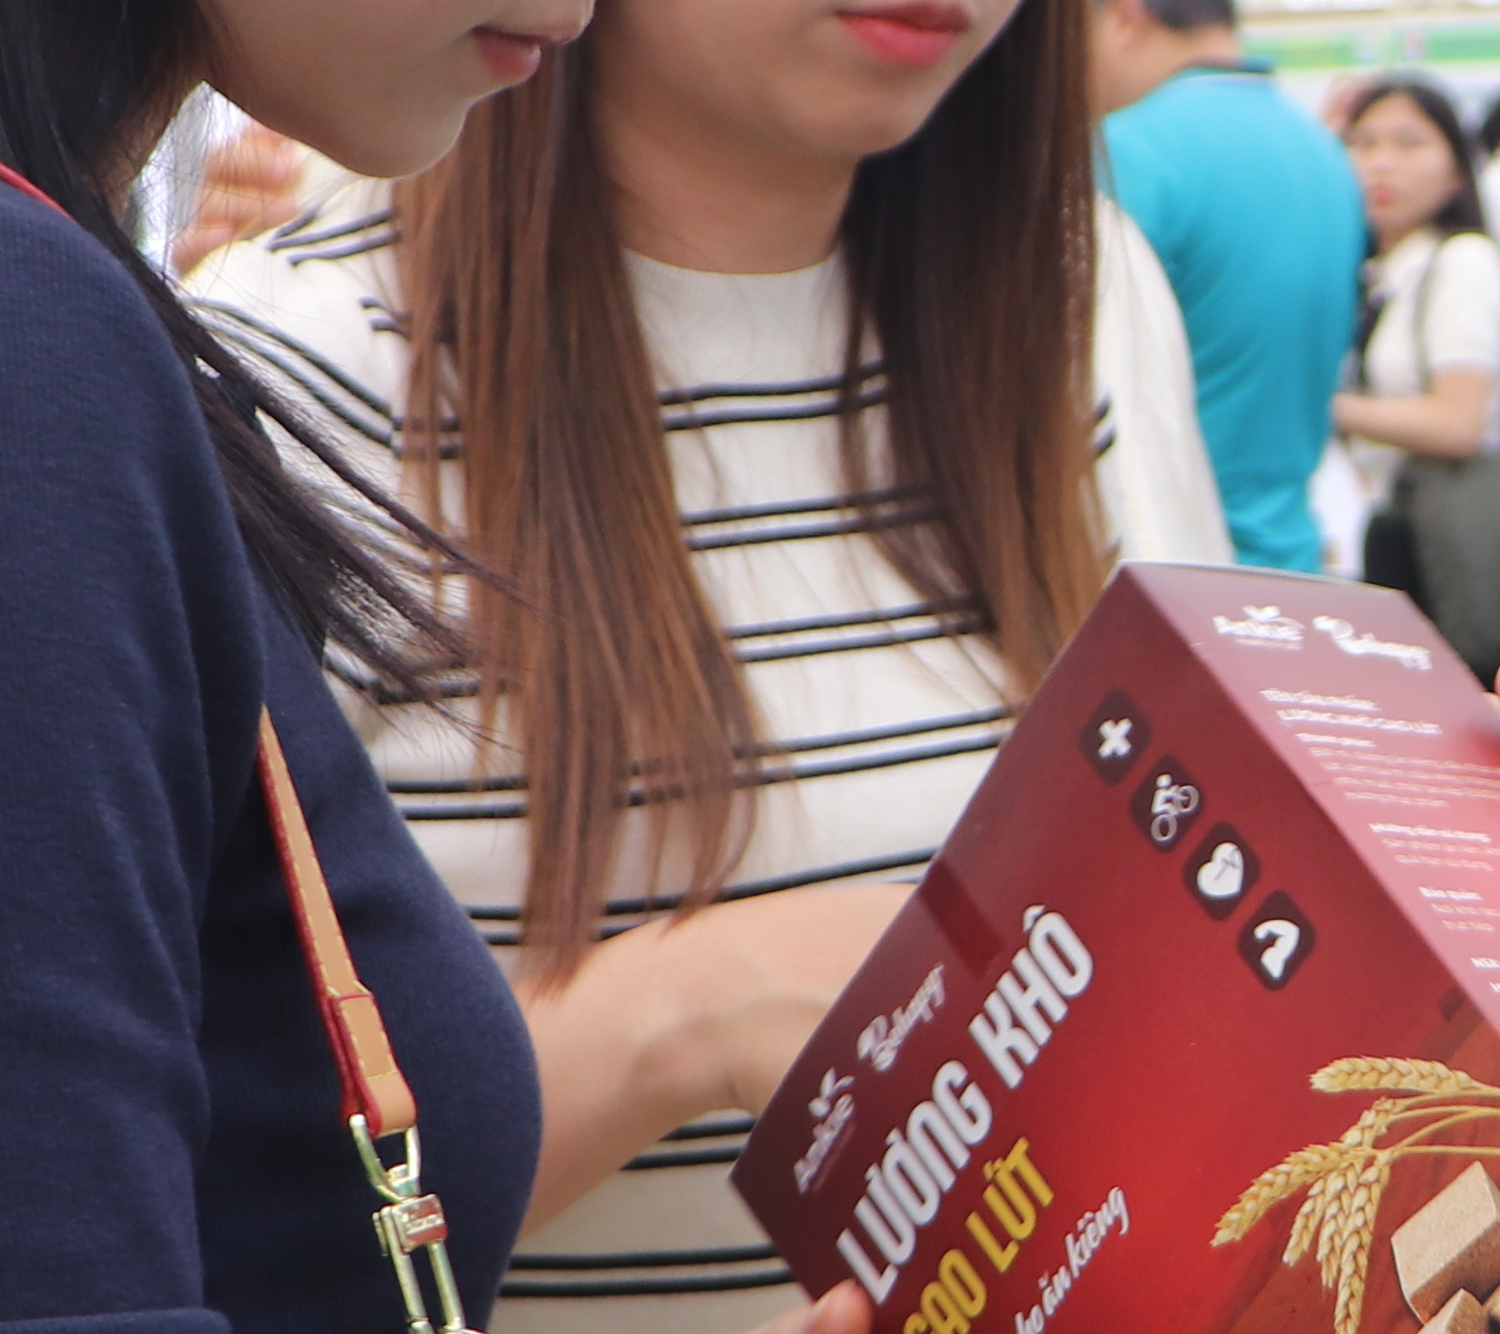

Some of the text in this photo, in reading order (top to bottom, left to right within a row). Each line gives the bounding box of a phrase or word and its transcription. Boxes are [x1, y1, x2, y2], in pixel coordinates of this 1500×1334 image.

[837, 904, 1094, 1305] LƯƠNG KHÔ
[965, 1136, 1055, 1273] LỨT
